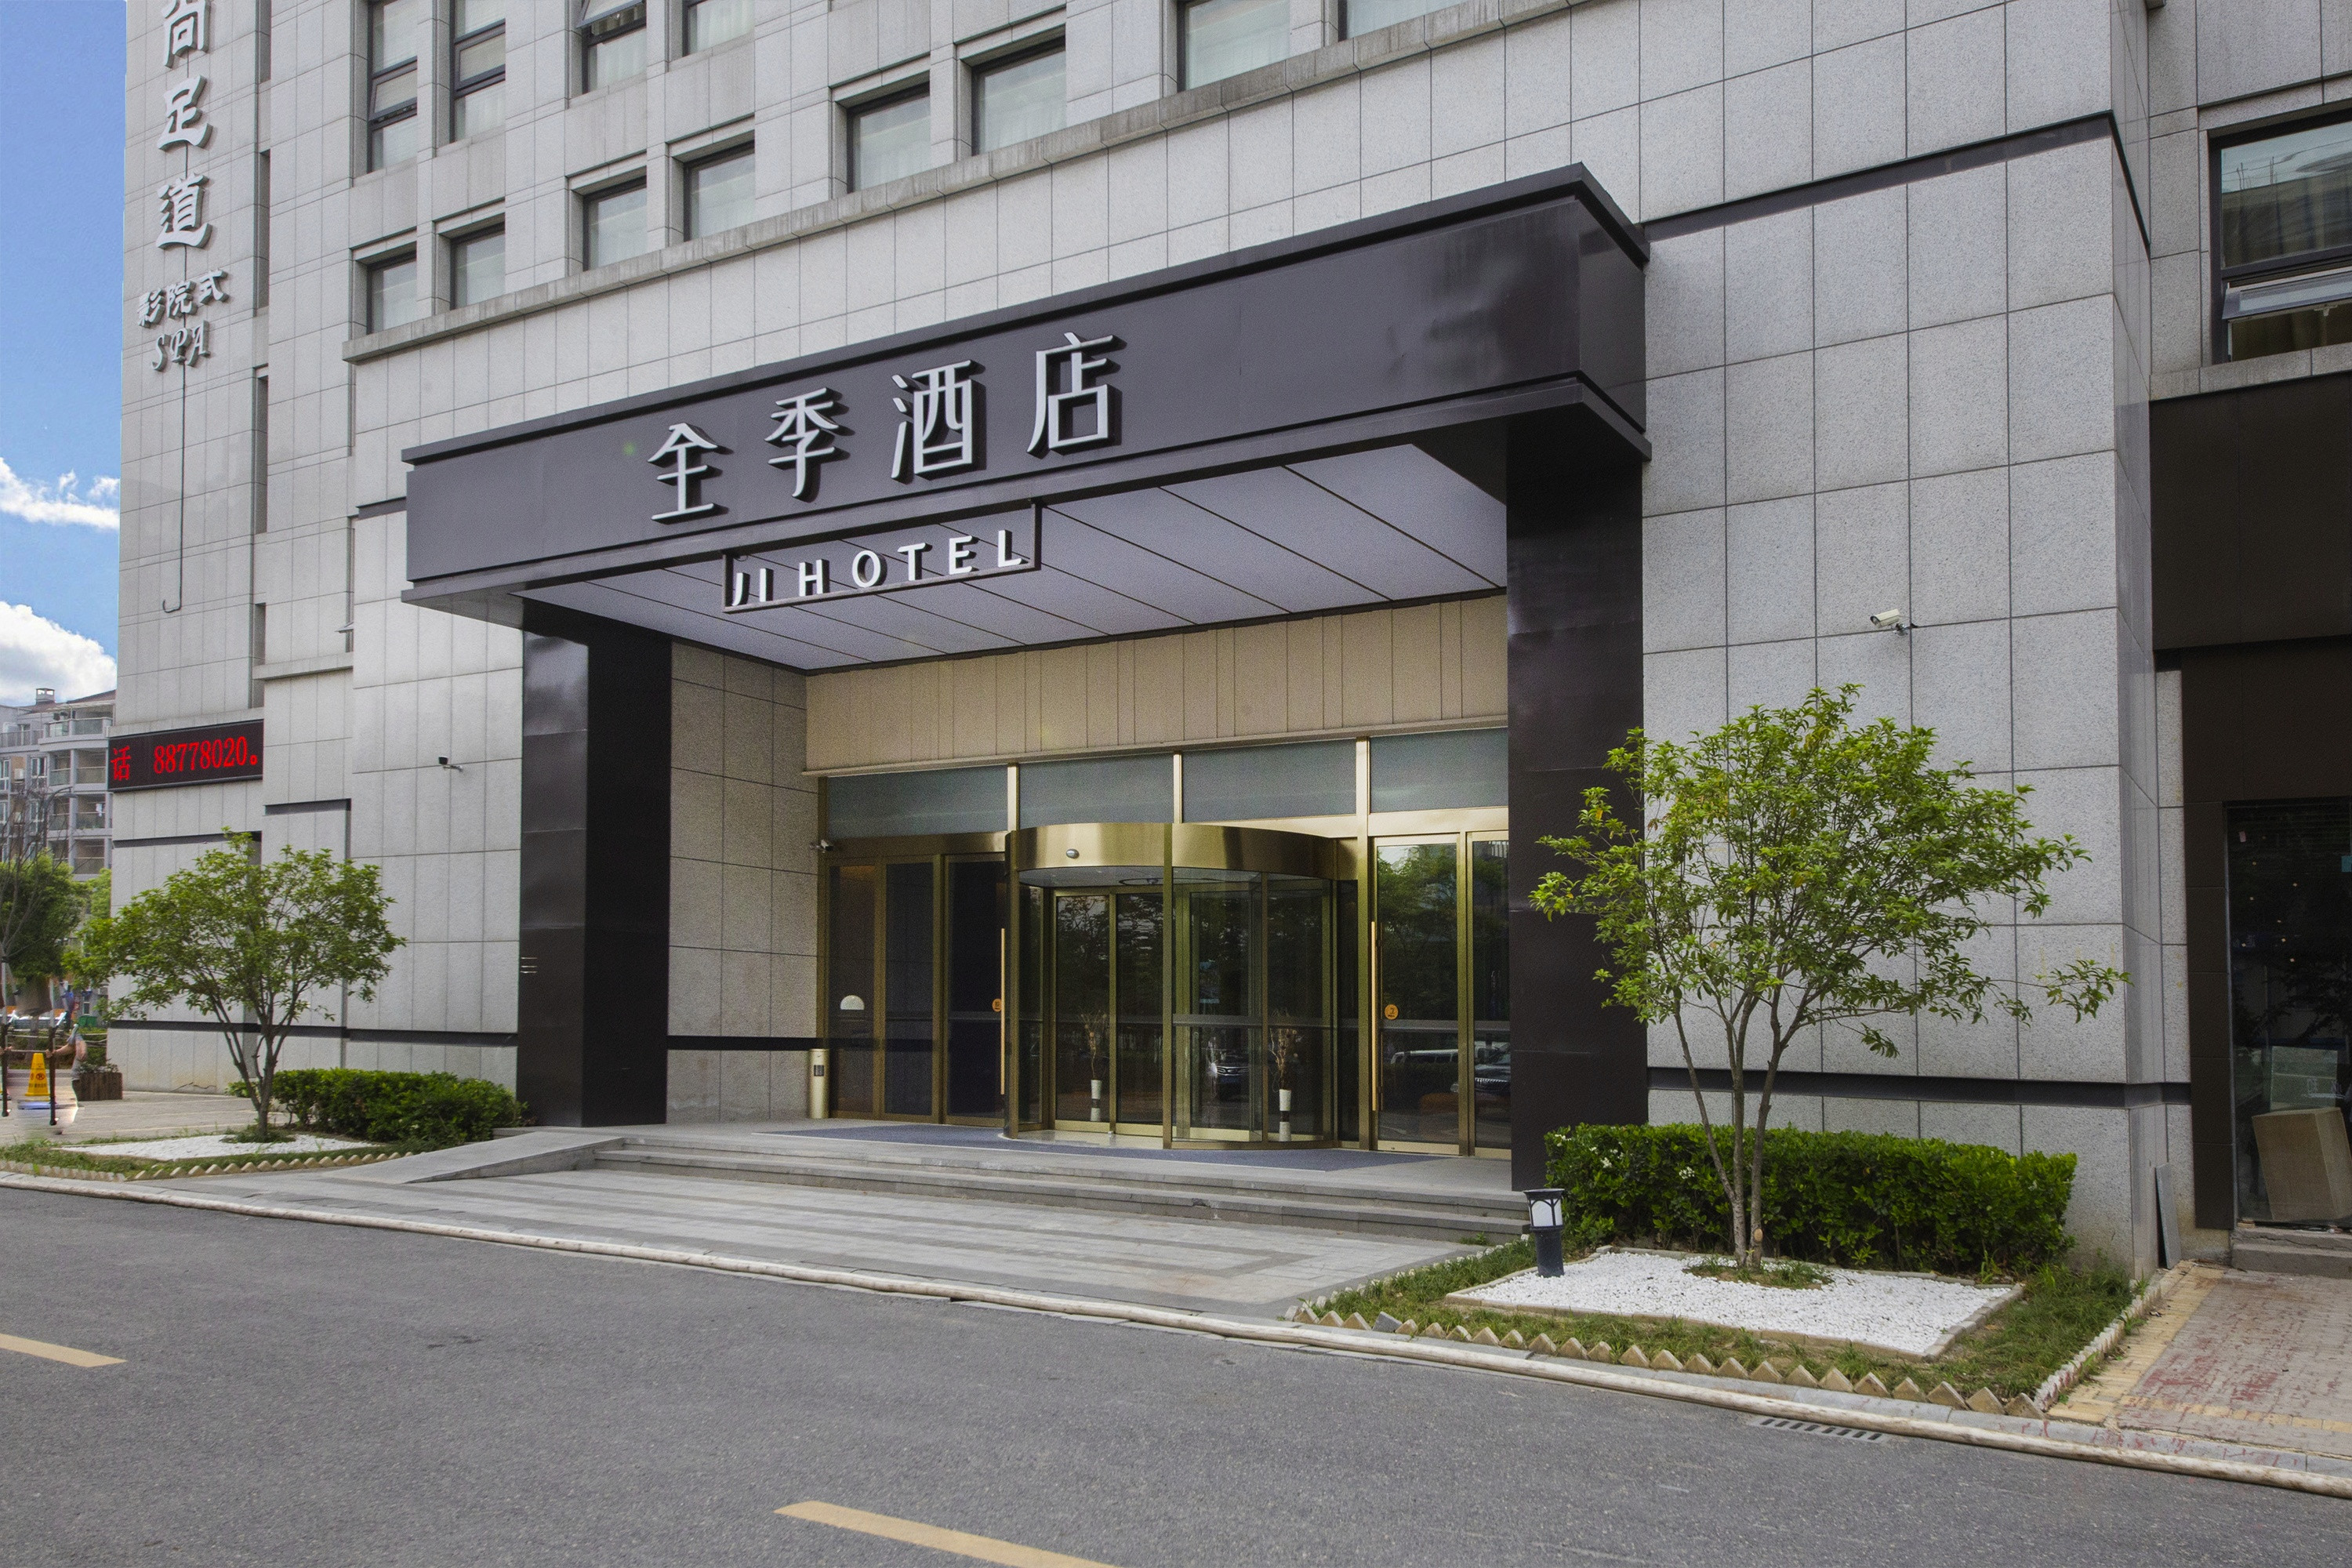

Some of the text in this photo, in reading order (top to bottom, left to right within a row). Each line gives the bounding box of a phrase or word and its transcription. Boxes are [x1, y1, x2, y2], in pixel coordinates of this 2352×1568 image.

[137, 268, 229, 327] 影院式
[152, 320, 211, 372] SPA
[648, 332, 1113, 521] 全季酒店
[732, 529, 1022, 606] JI HOTEL
[111, 746, 131, 781] 话
